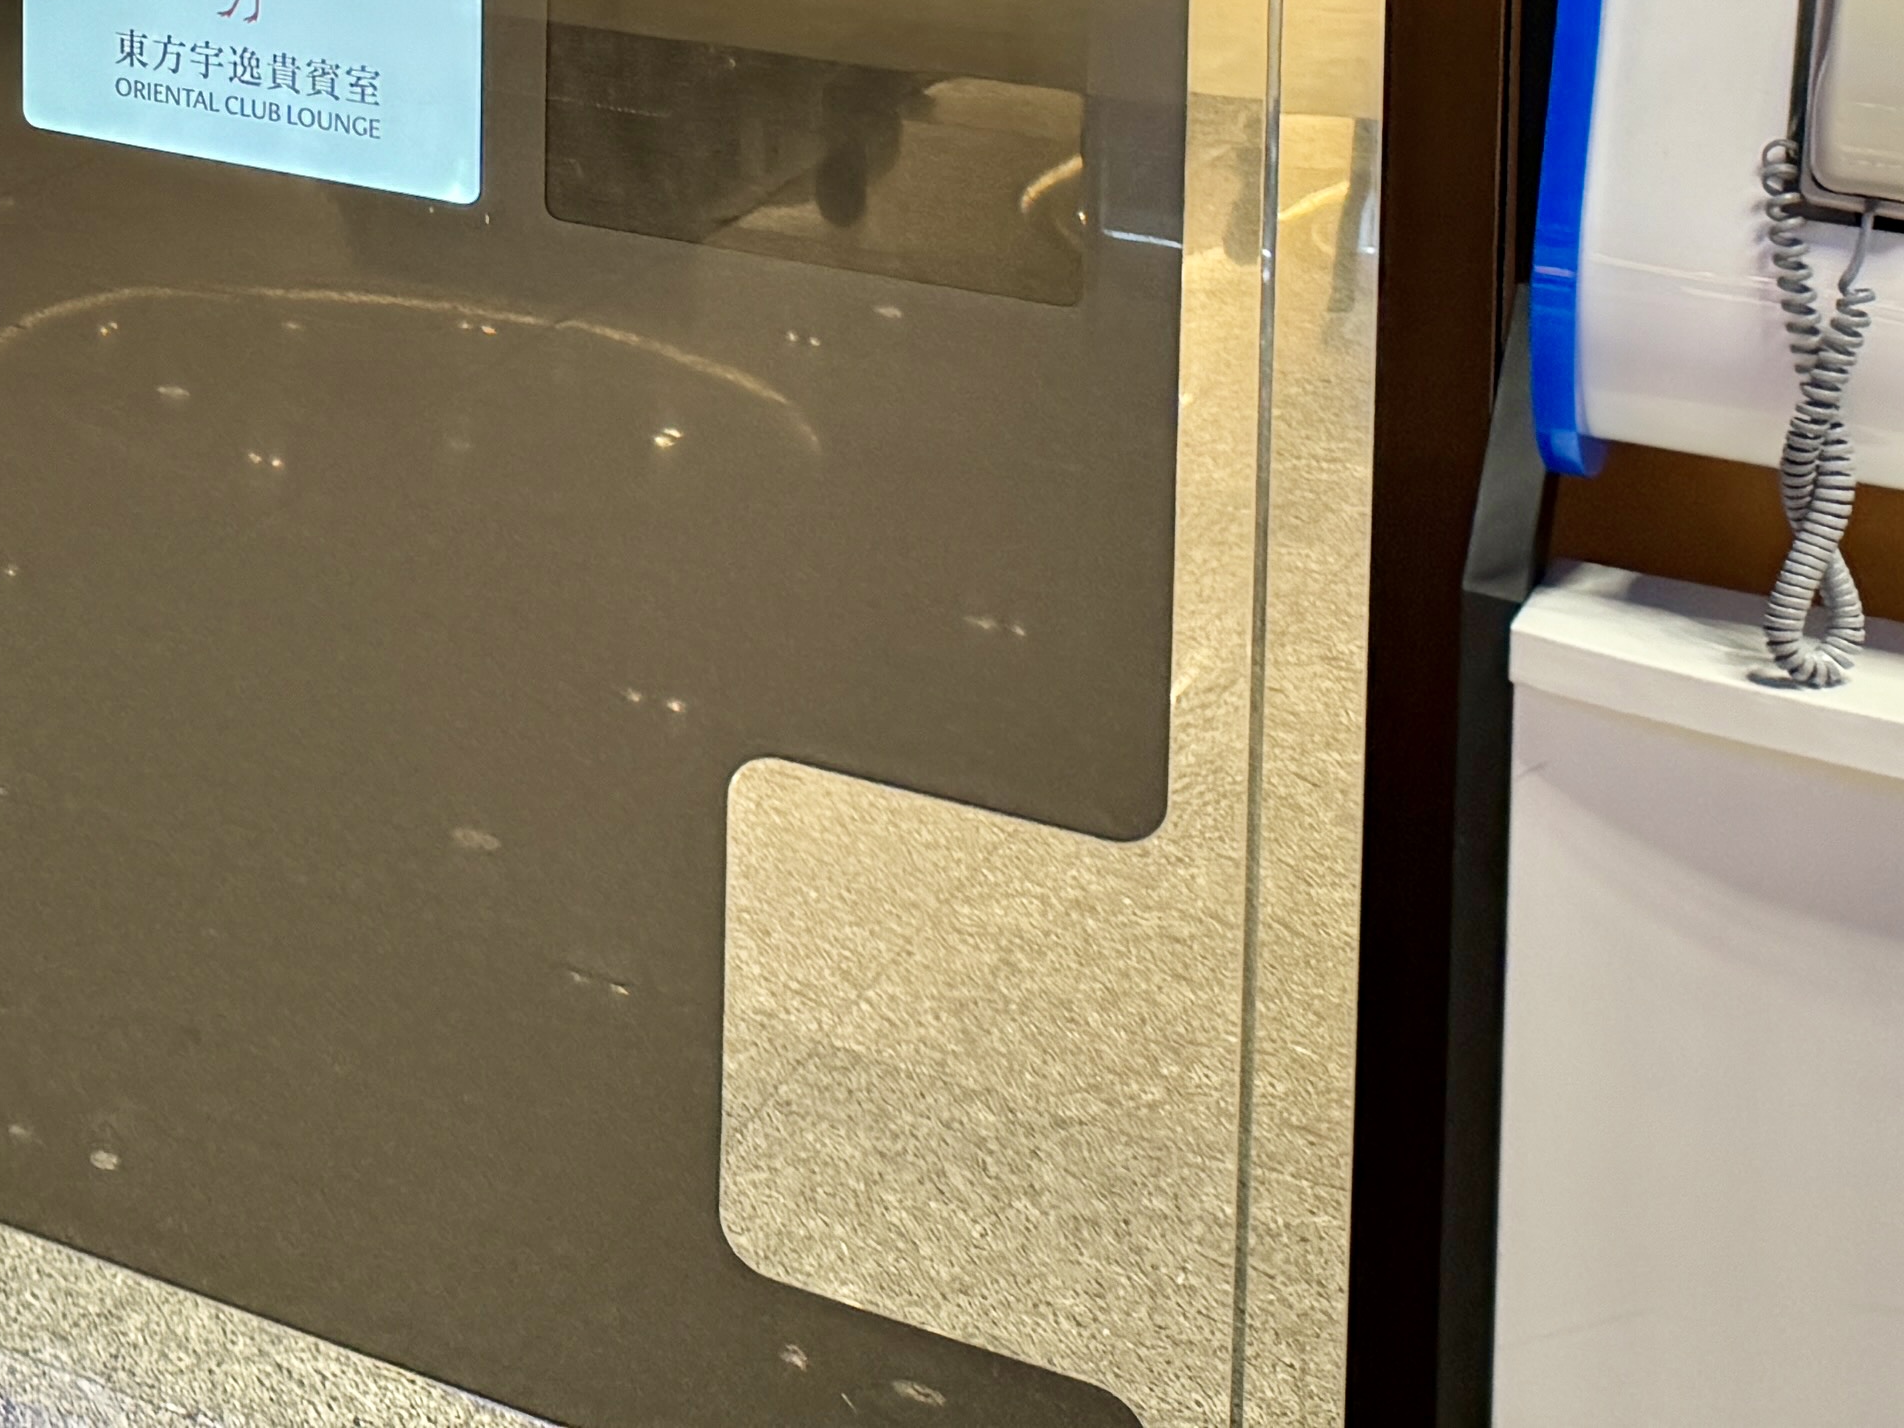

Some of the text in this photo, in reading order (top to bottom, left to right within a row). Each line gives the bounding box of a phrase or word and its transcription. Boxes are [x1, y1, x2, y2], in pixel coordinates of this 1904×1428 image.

[114, 27, 383, 107] 東方宇逸貴賓室
[114, 76, 382, 140] ORIENTAL CLUB LOUNGE
